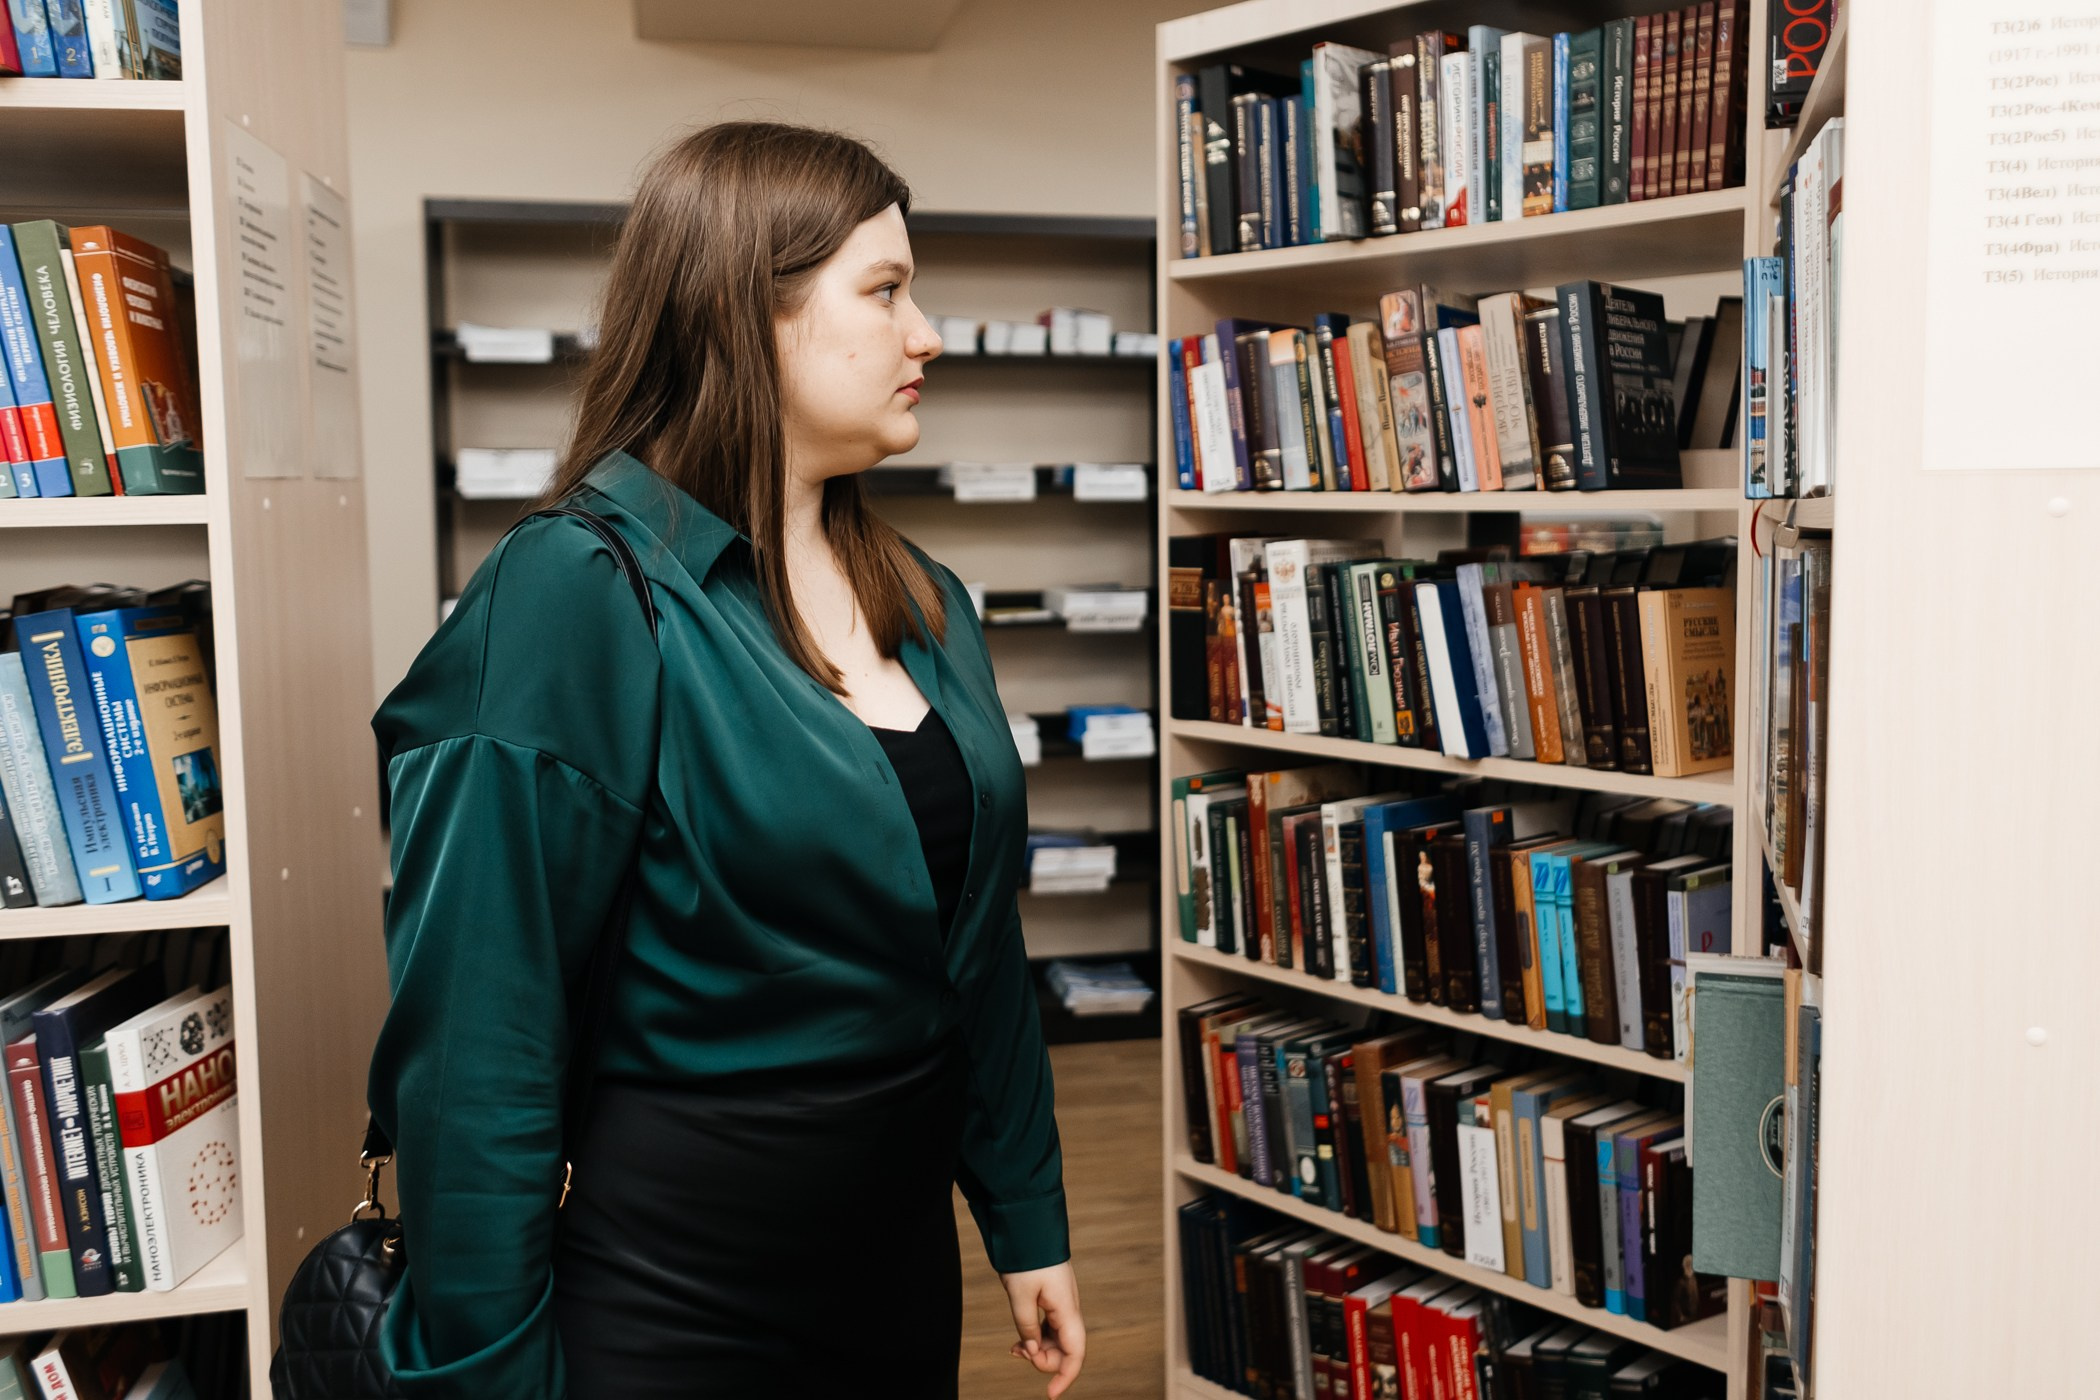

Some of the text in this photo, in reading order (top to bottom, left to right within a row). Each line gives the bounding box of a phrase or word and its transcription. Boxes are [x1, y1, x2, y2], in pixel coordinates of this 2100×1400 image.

[1449, 62, 1463, 123] ИСТОРИЯ
[1610, 75, 1624, 122] История
[1611, 123, 1623, 164] России
[35, 265, 81, 431] ФИЗИОЛОГИЯ ЧЕЛОВЕКА
[1538, 322, 1552, 375] ДЕКАБРИСТЫ
[42, 641, 84, 753] ЭЛЕКТРОНИКА
[91, 671, 128, 792] ИНФОРМАЦИОННЫЕ
[111, 701, 133, 758] СИСТЕМЫ
[72, 777, 98, 854] Импульсная
[86, 773, 112, 851] электроника
[130, 1151, 165, 1281] НАНОЭЛЕКТРОНИКА
